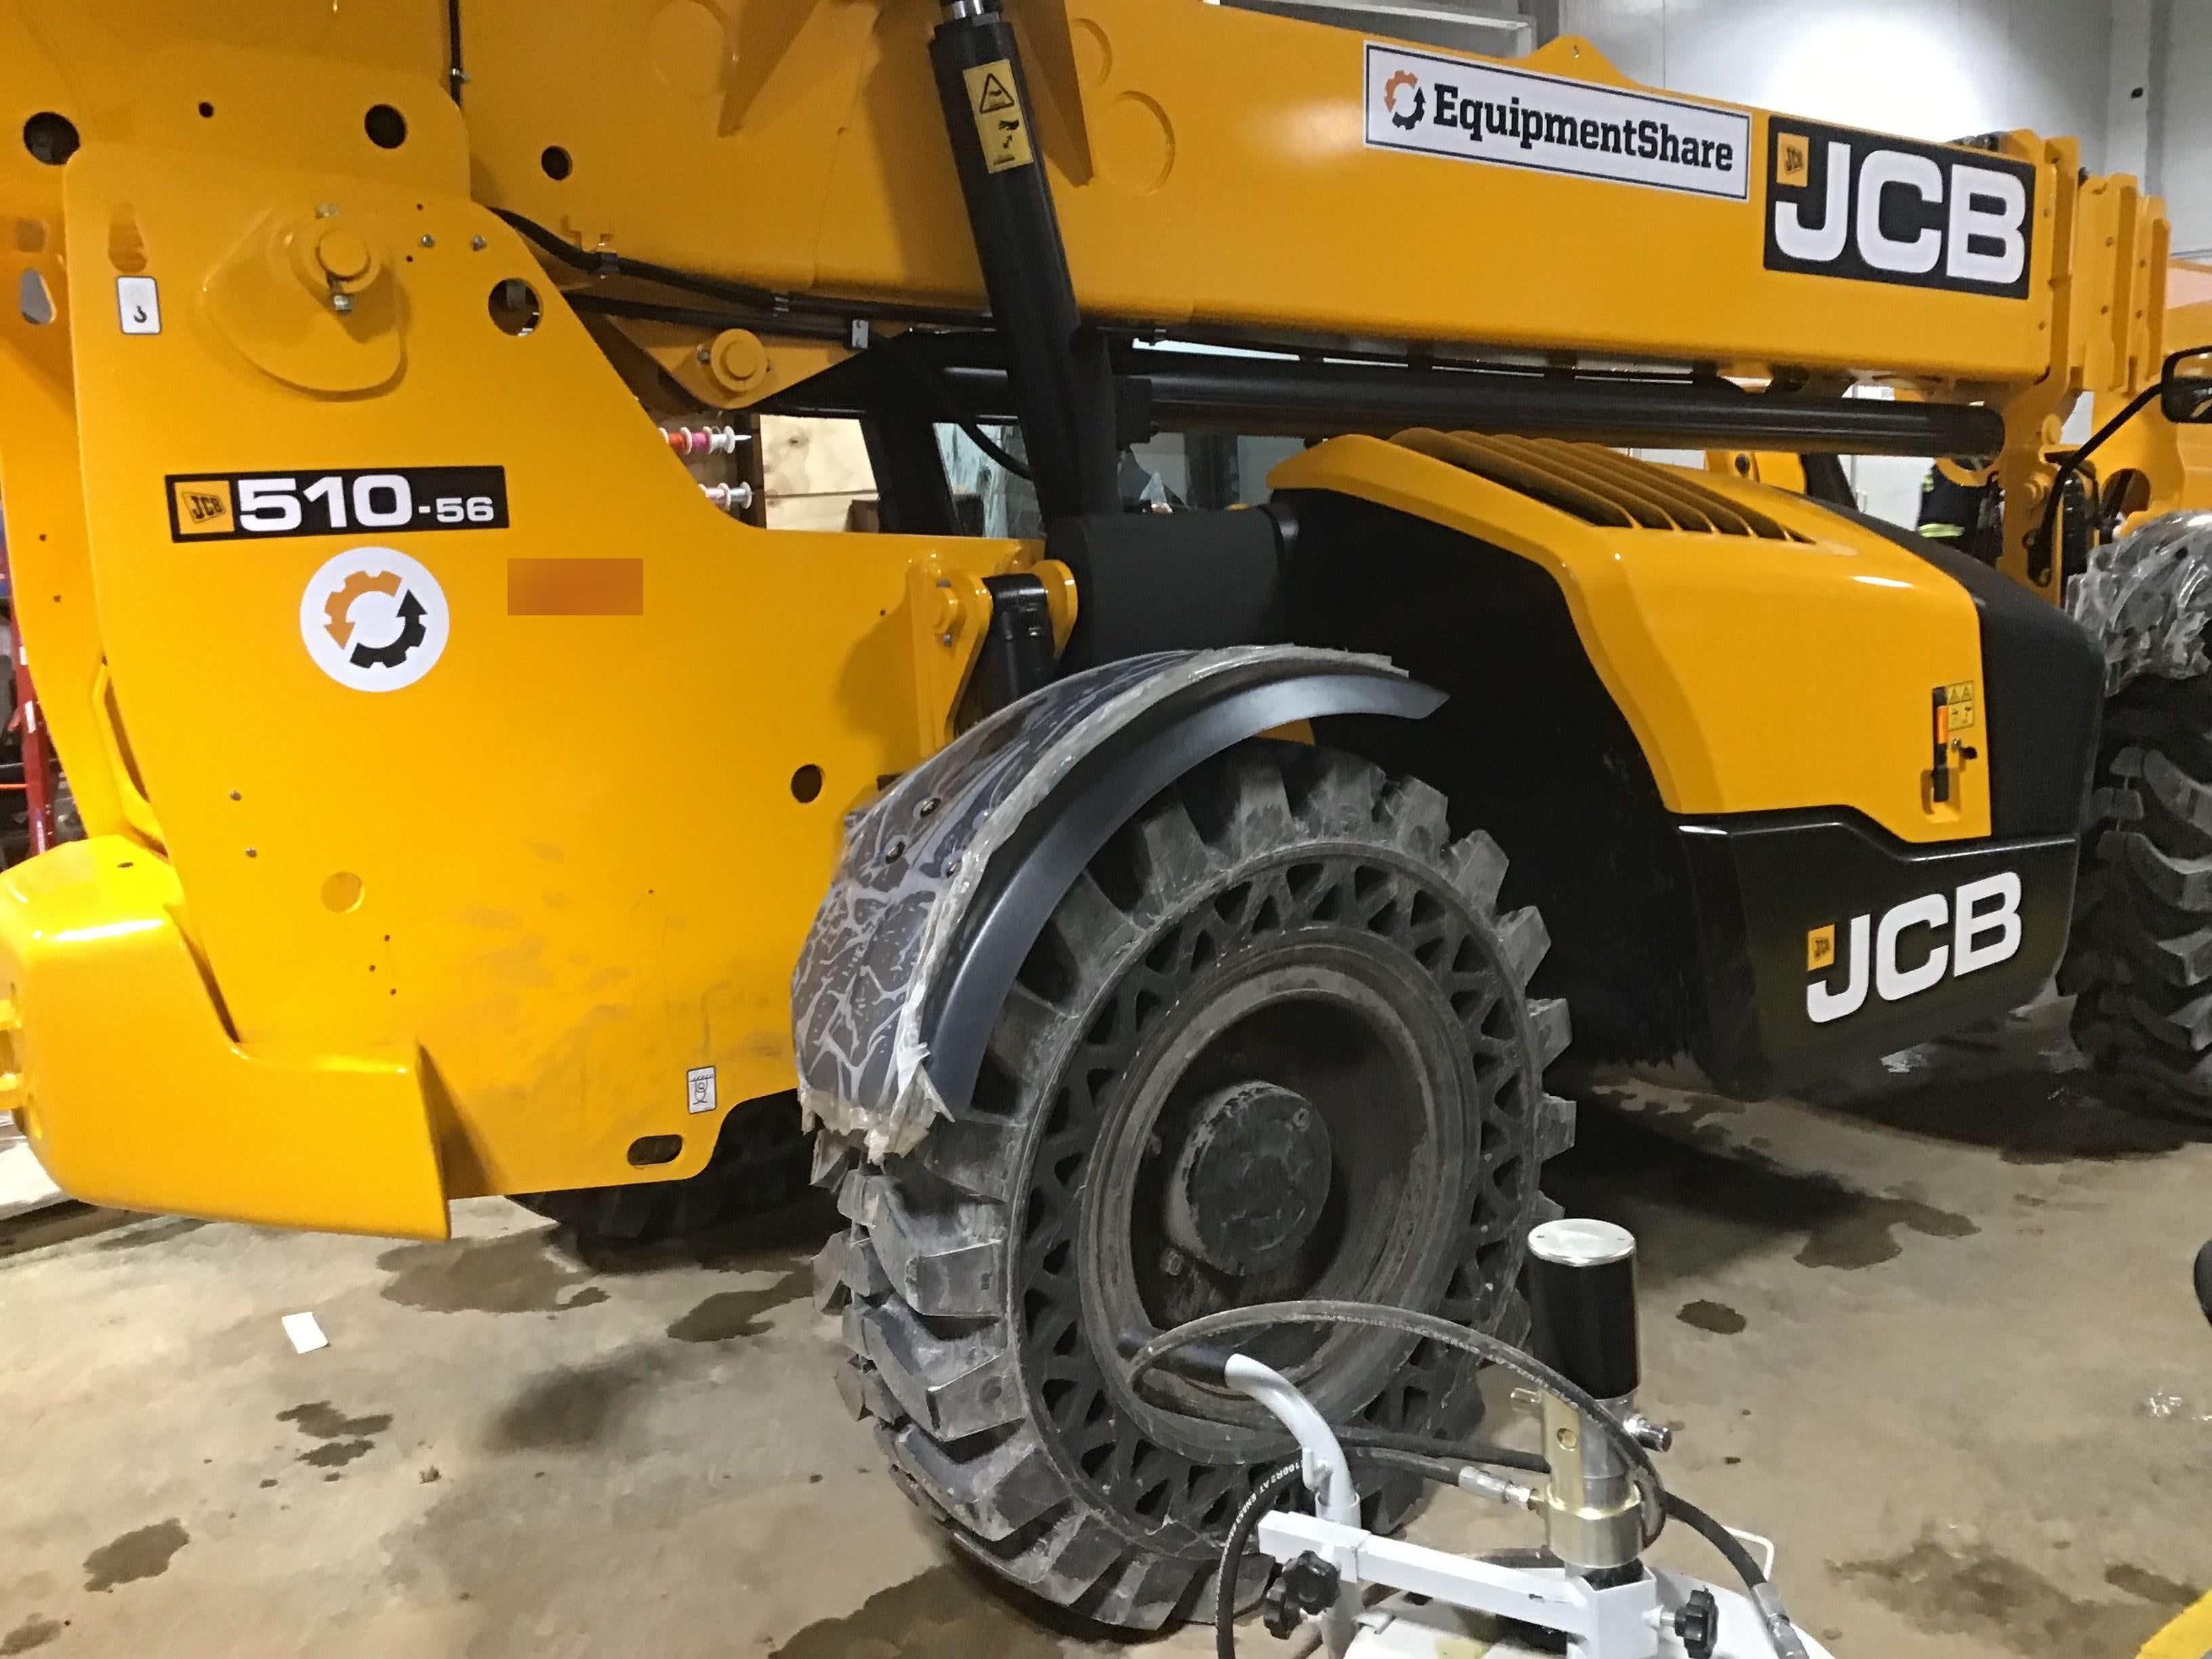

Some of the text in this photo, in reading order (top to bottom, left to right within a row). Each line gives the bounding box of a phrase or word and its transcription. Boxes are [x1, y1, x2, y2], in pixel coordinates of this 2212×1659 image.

[1434, 83, 1734, 171] EquipmentShare
[1774, 140, 2026, 284] JCB
[190, 495, 224, 520] JCB
[1806, 871, 2022, 1023] JCB
